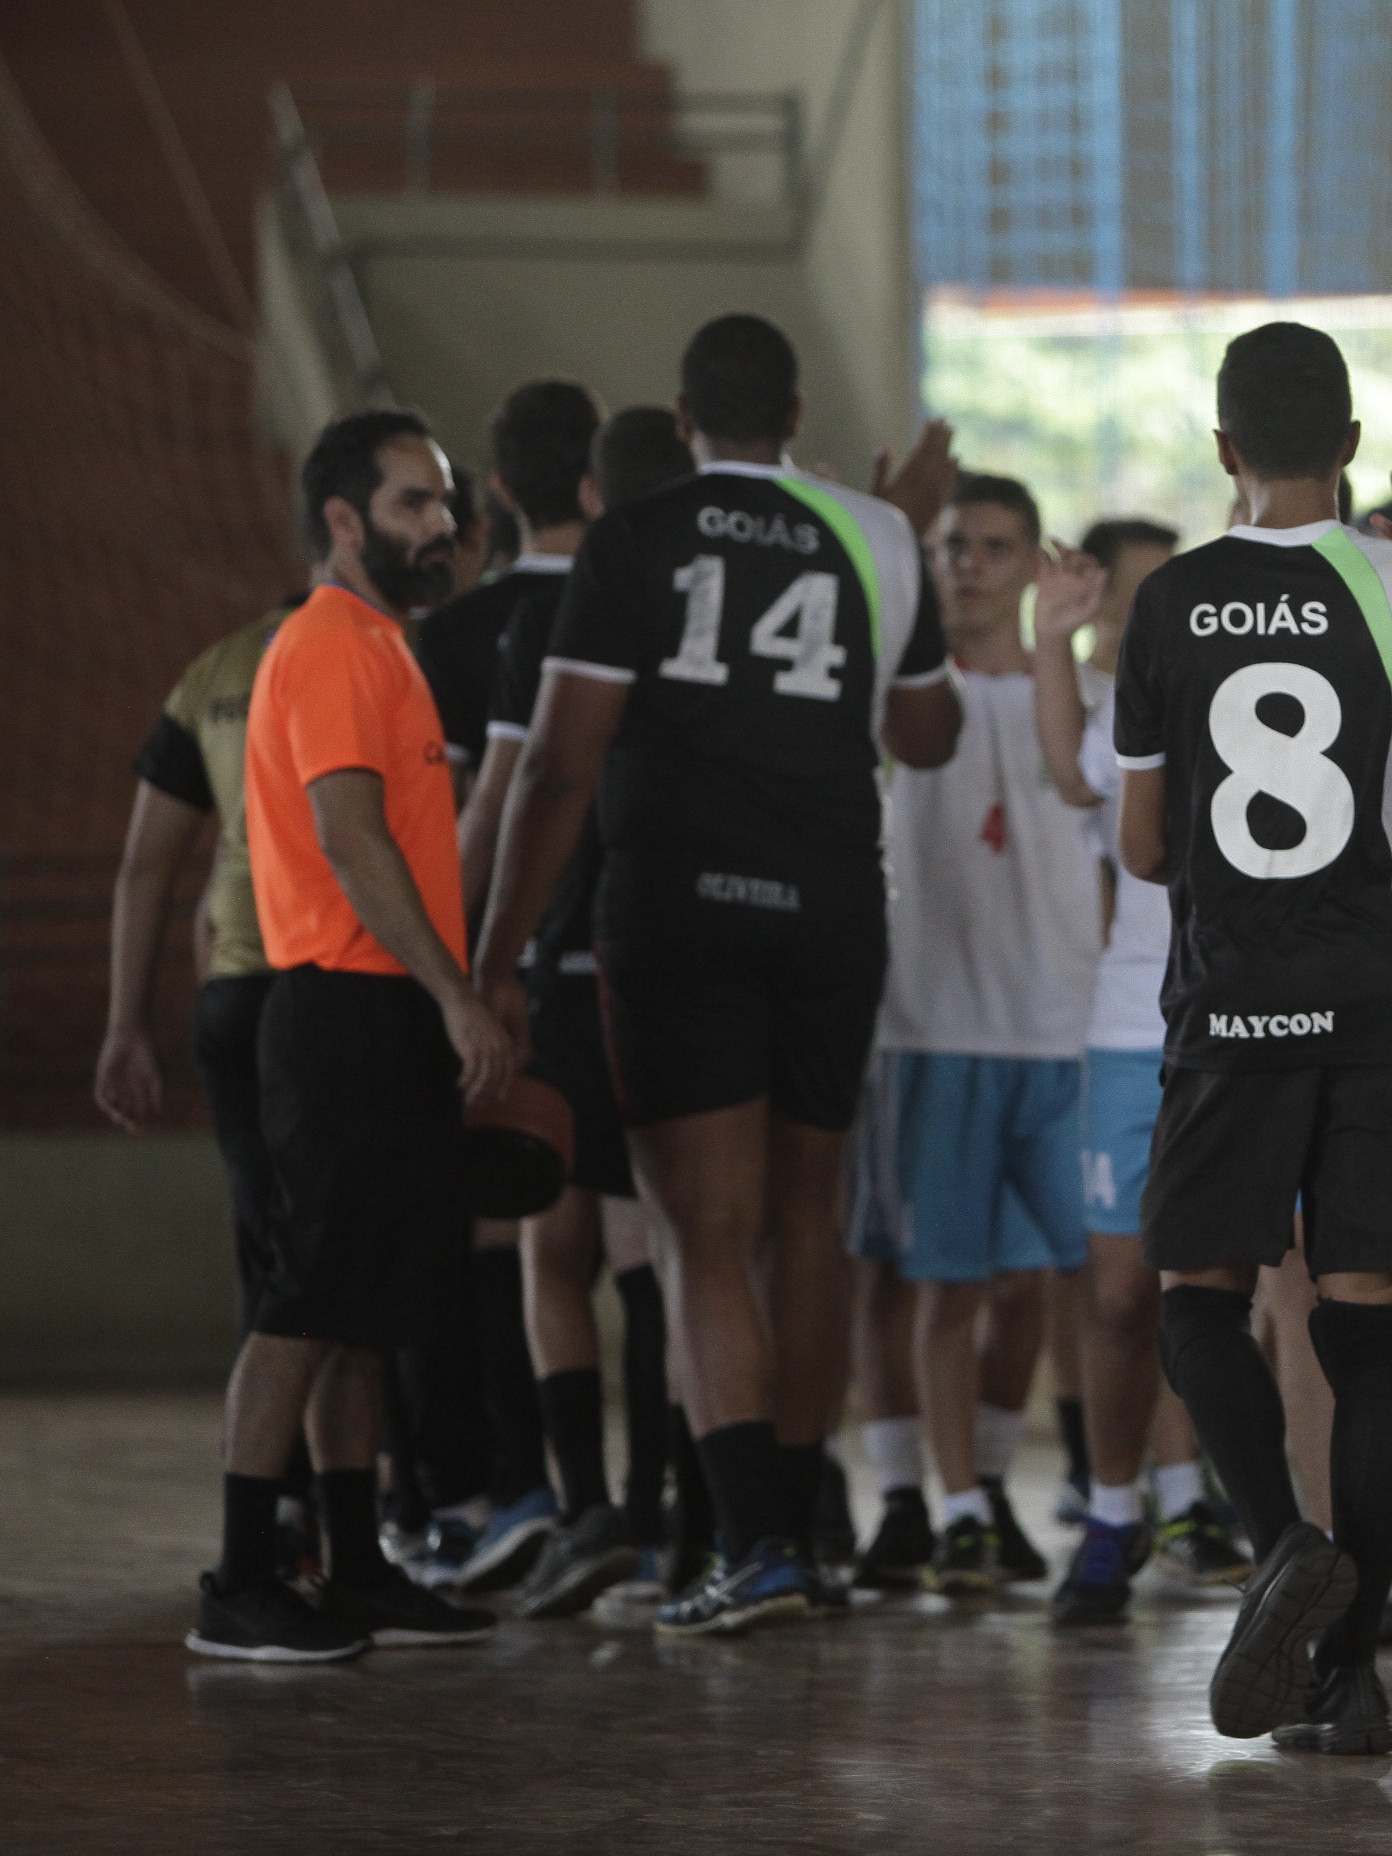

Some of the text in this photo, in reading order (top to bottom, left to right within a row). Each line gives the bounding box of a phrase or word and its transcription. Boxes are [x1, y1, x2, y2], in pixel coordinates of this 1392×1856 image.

[659, 554, 848, 701] 14
[1189, 594, 1330, 637] GOIÁS
[1208, 662, 1355, 880] 8
[1208, 1011, 1335, 1039] MAYCON
